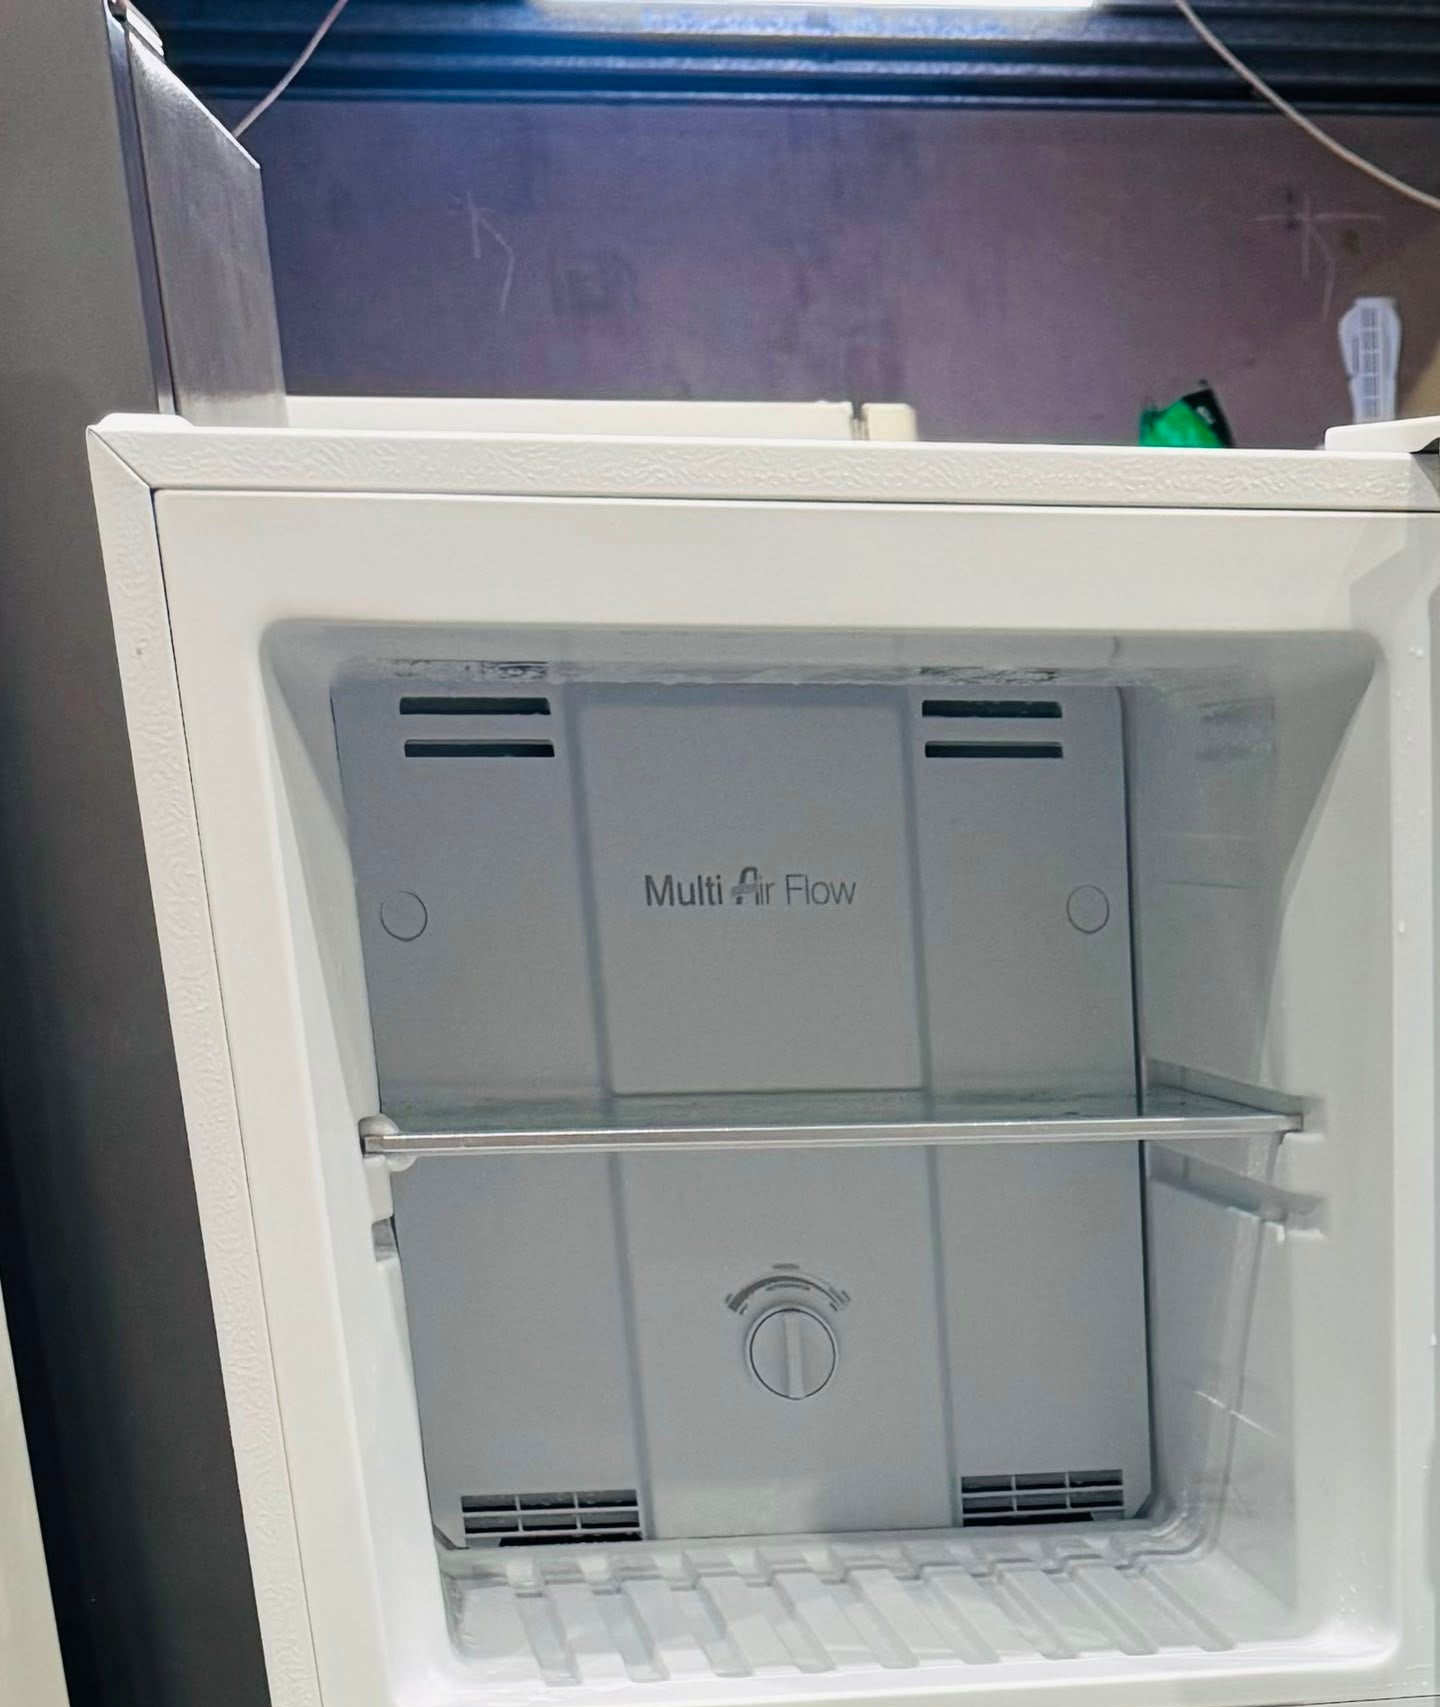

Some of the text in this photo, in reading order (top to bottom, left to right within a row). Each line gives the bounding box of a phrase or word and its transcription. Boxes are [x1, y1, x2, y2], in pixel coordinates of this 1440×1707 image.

[645, 866, 857, 907] Multi Air Flow
